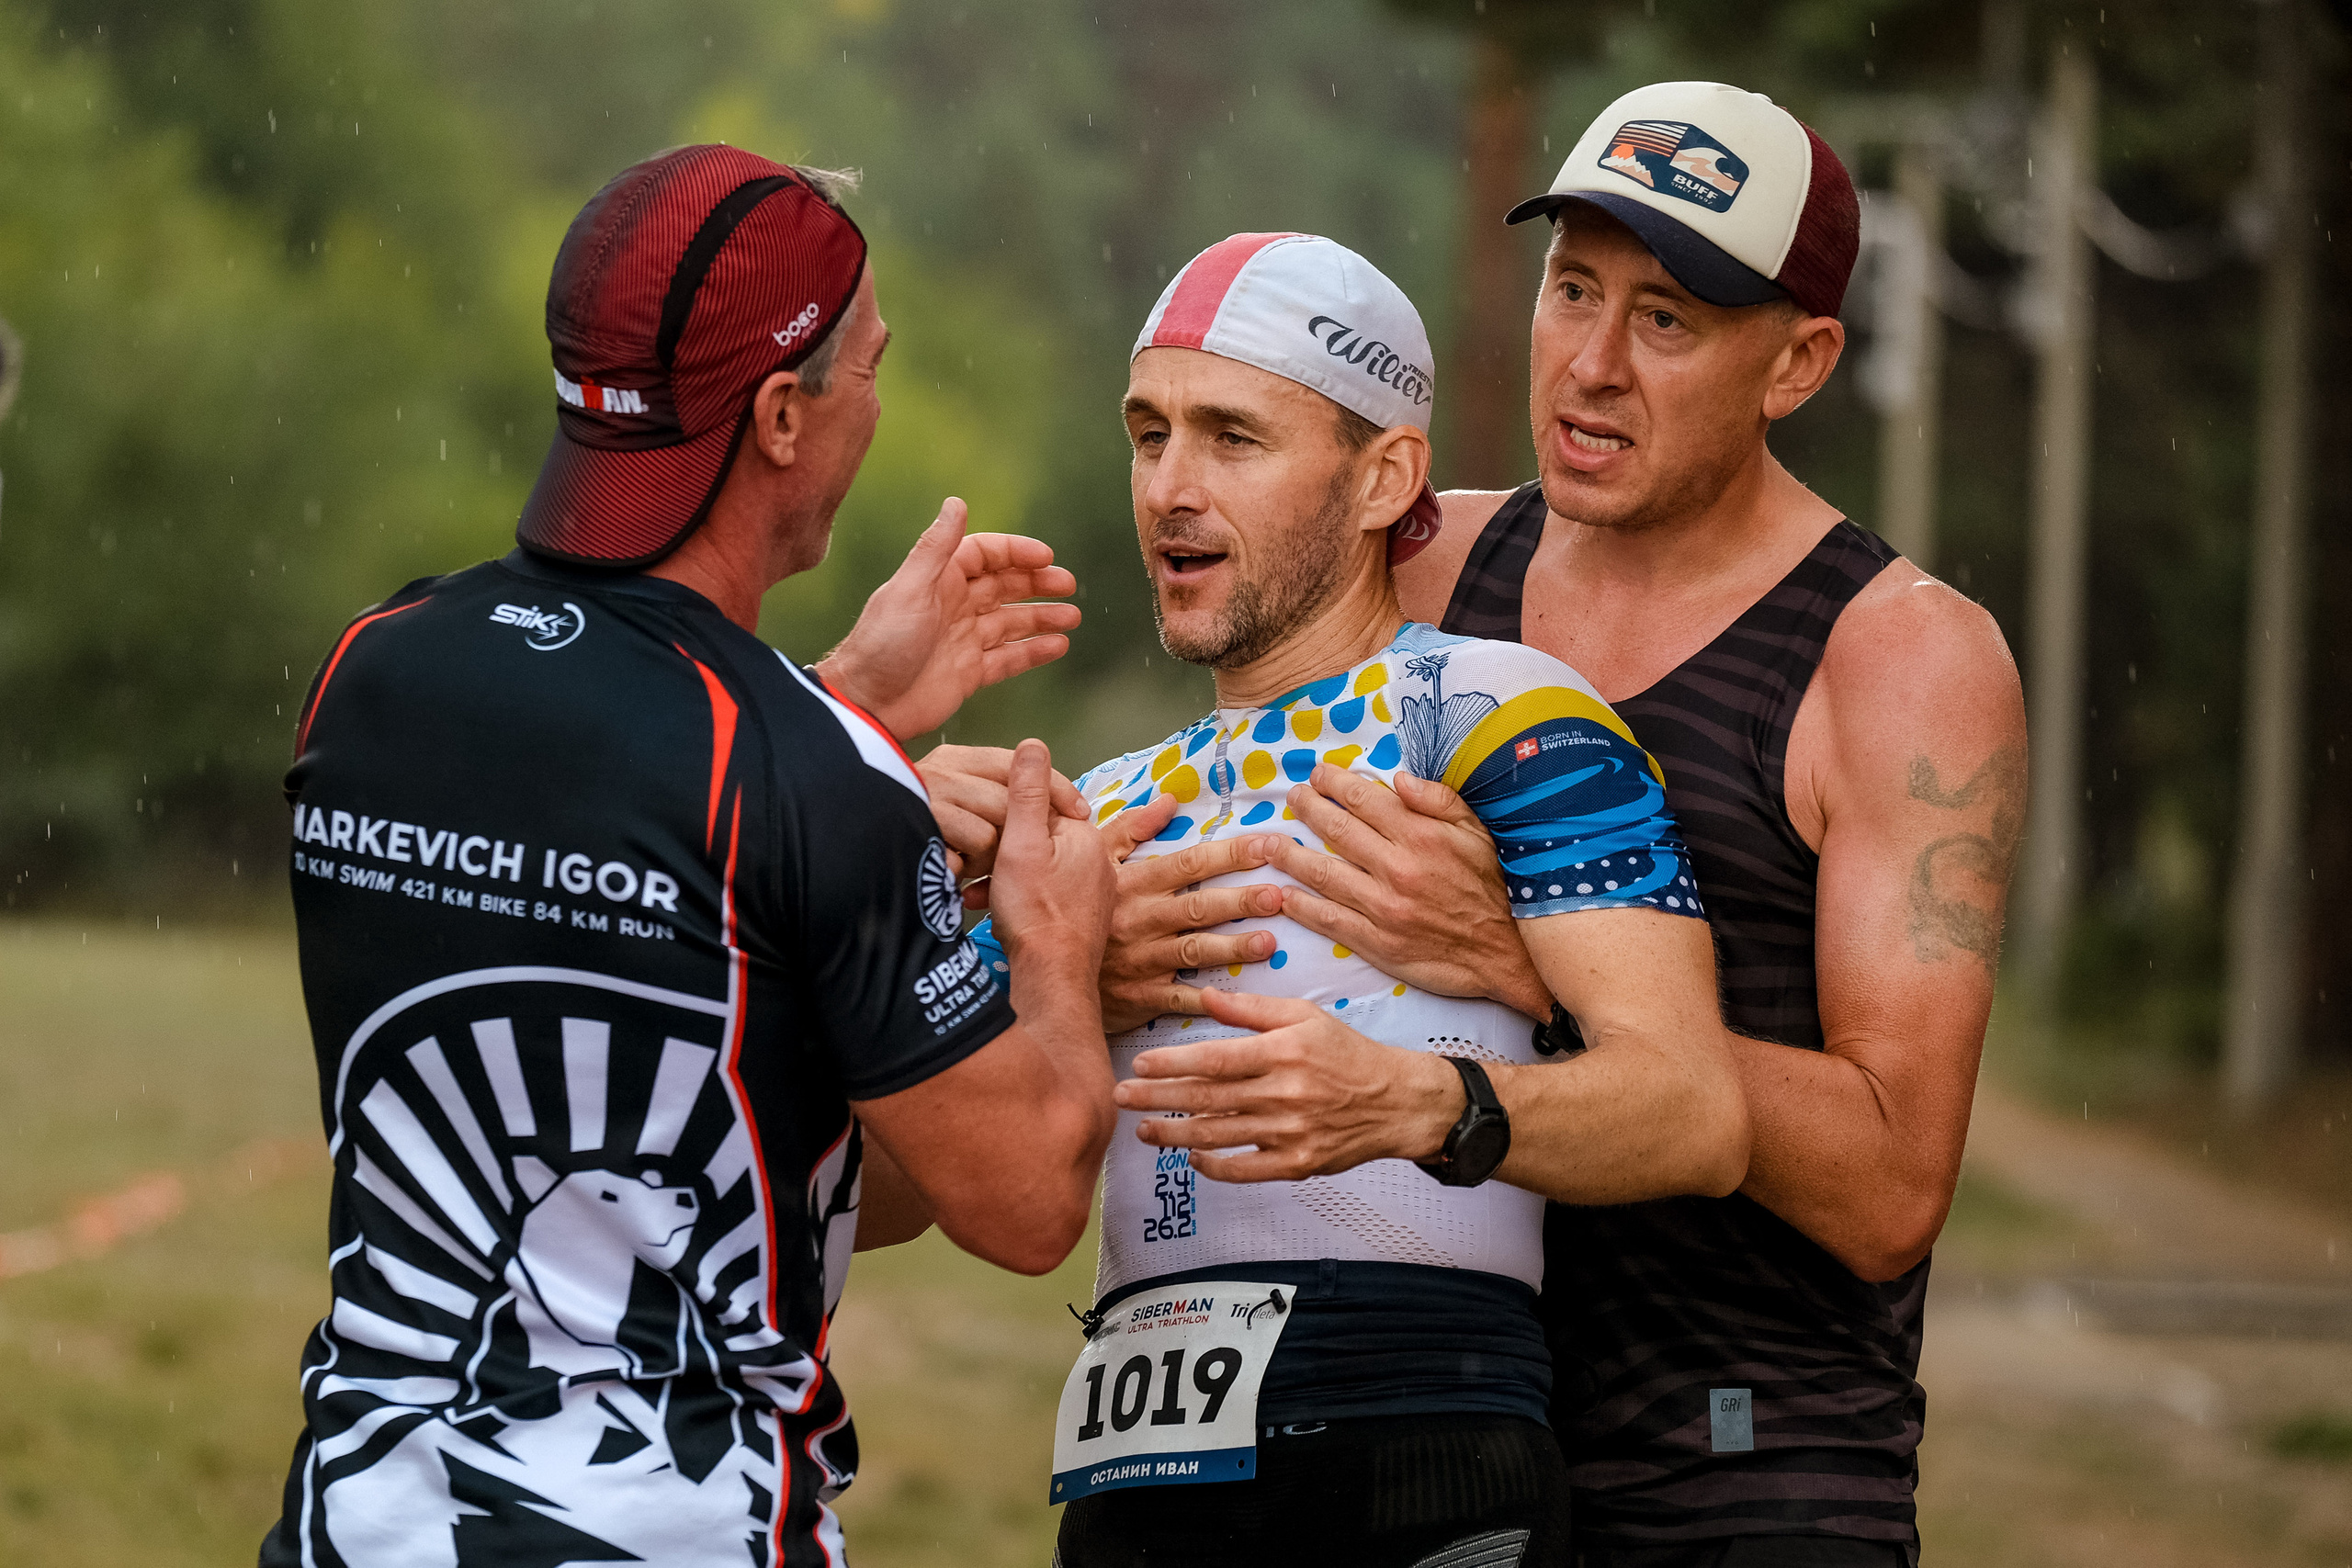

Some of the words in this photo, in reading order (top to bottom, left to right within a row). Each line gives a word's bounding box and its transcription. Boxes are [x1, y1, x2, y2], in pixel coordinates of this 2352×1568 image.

[1672, 174, 1719, 199] BUFF
[1307, 315, 1431, 405] Wilier
[1540, 731, 1569, 744] BORN
[1541, 737, 1611, 751] SWITZERLAND
[542, 849, 680, 913] IGOR
[308, 857, 334, 880] KM
[338, 863, 395, 893] SWIM
[400, 878, 435, 901] 421
[441, 886, 474, 908] KM
[479, 893, 527, 918] BIKE
[533, 901, 562, 924] 84
[571, 909, 609, 932] KM
[618, 917, 675, 941] RUN
[924, 985, 975, 1023] ULTRA
[1156, 1152, 1189, 1172] KON
[1143, 1215, 1192, 1243] 26.2
[1131, 1297, 1215, 1323] SIBERMAN
[1127, 1322, 1154, 1335] ULTRA
[1158, 1314, 1210, 1329] TRIATHLON
[1077, 1347, 1243, 1443] 1019
[1091, 1463, 1151, 1486] ОСТАНИН
[1155, 1461, 1200, 1476] ИВАН
